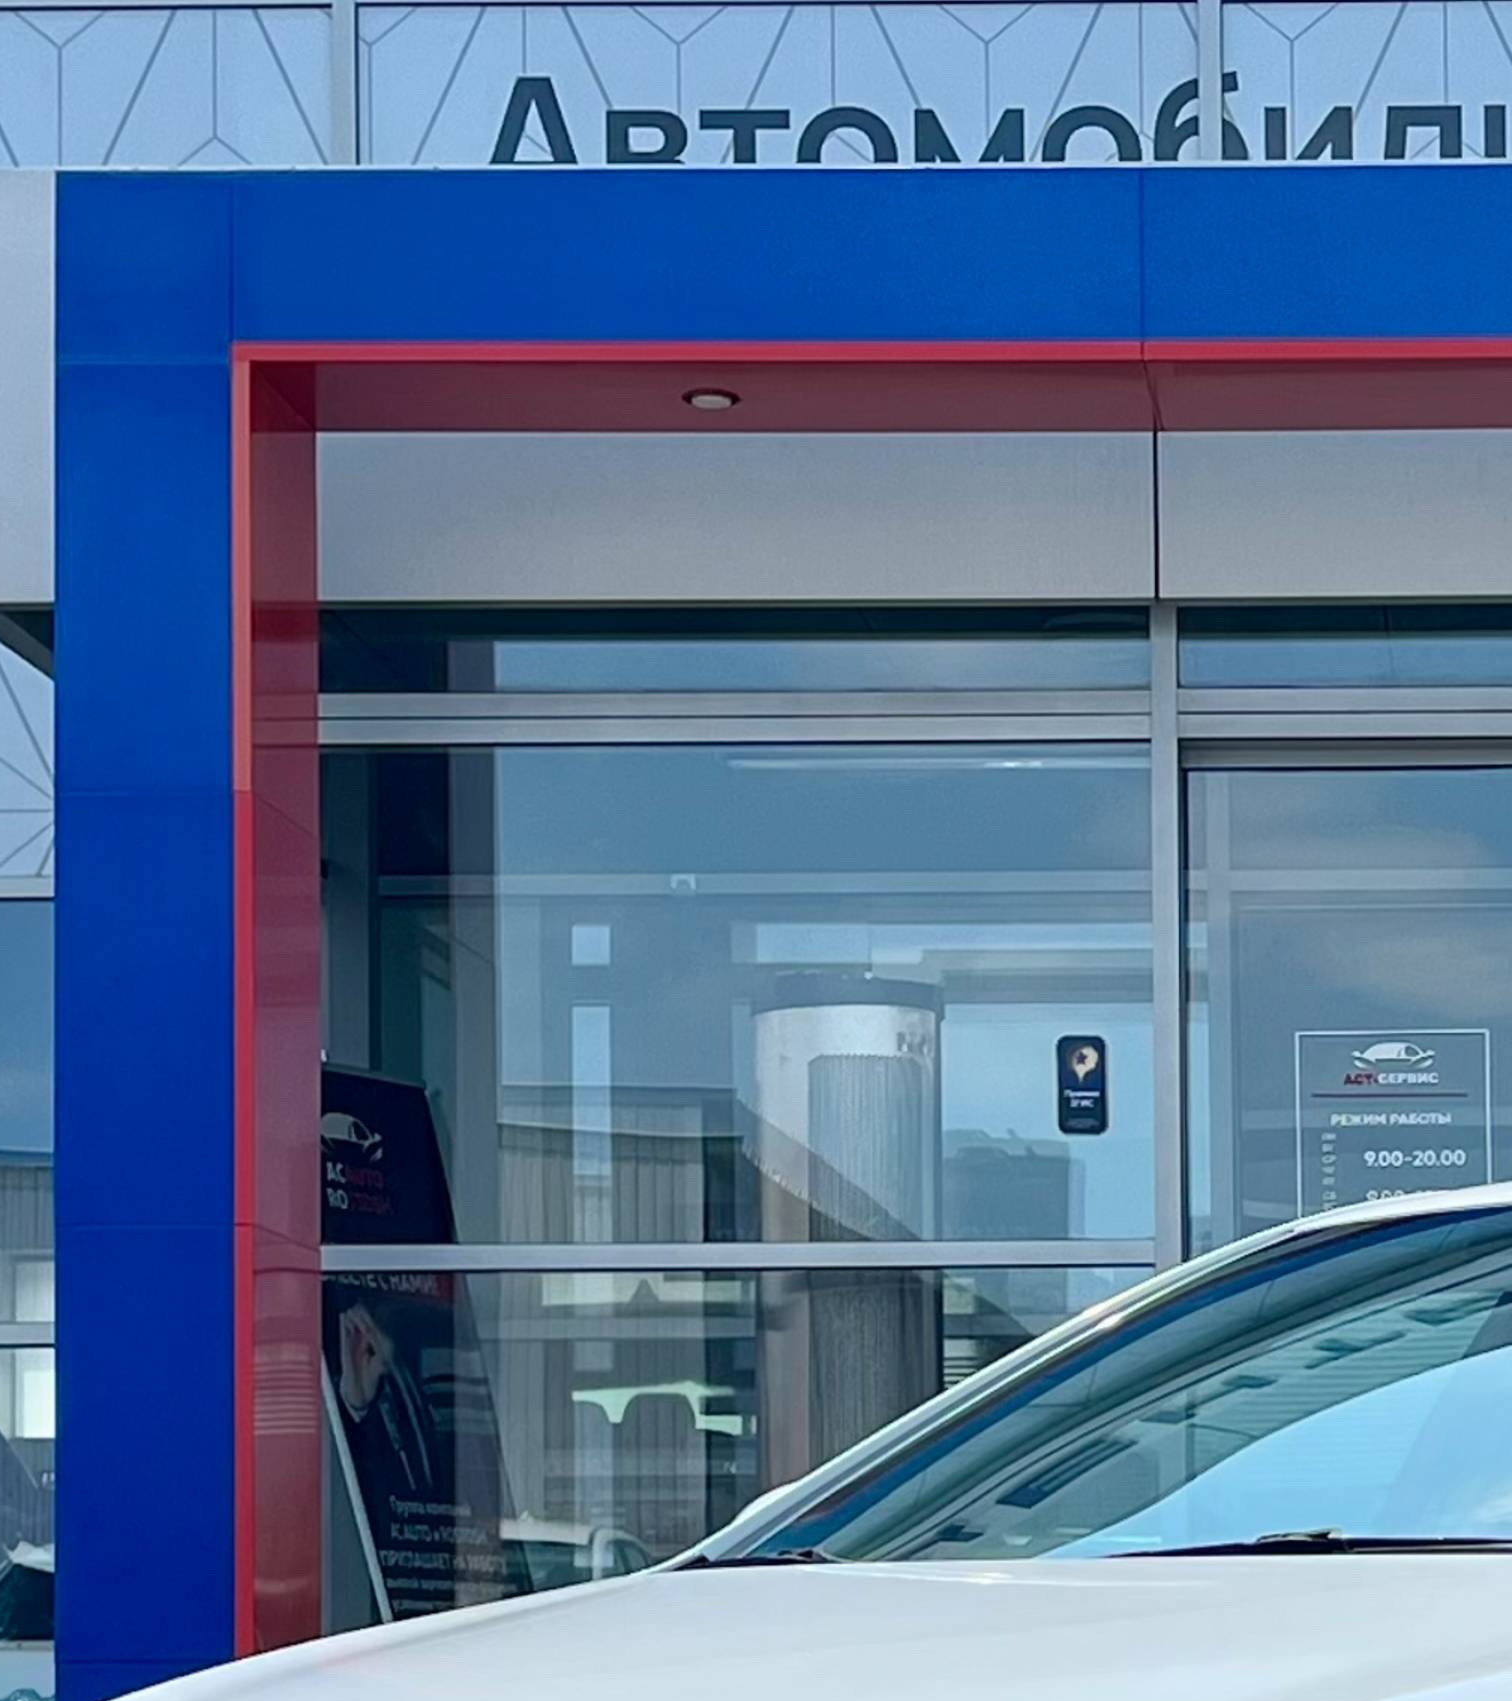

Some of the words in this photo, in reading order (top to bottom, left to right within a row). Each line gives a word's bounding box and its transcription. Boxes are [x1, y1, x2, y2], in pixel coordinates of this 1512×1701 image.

[1330, 1114, 1387, 1126] РЕЖИМ
[1389, 1113, 1451, 1125] РАБОТЫ
[1363, 1149, 1466, 1167] 9.00-20.00
